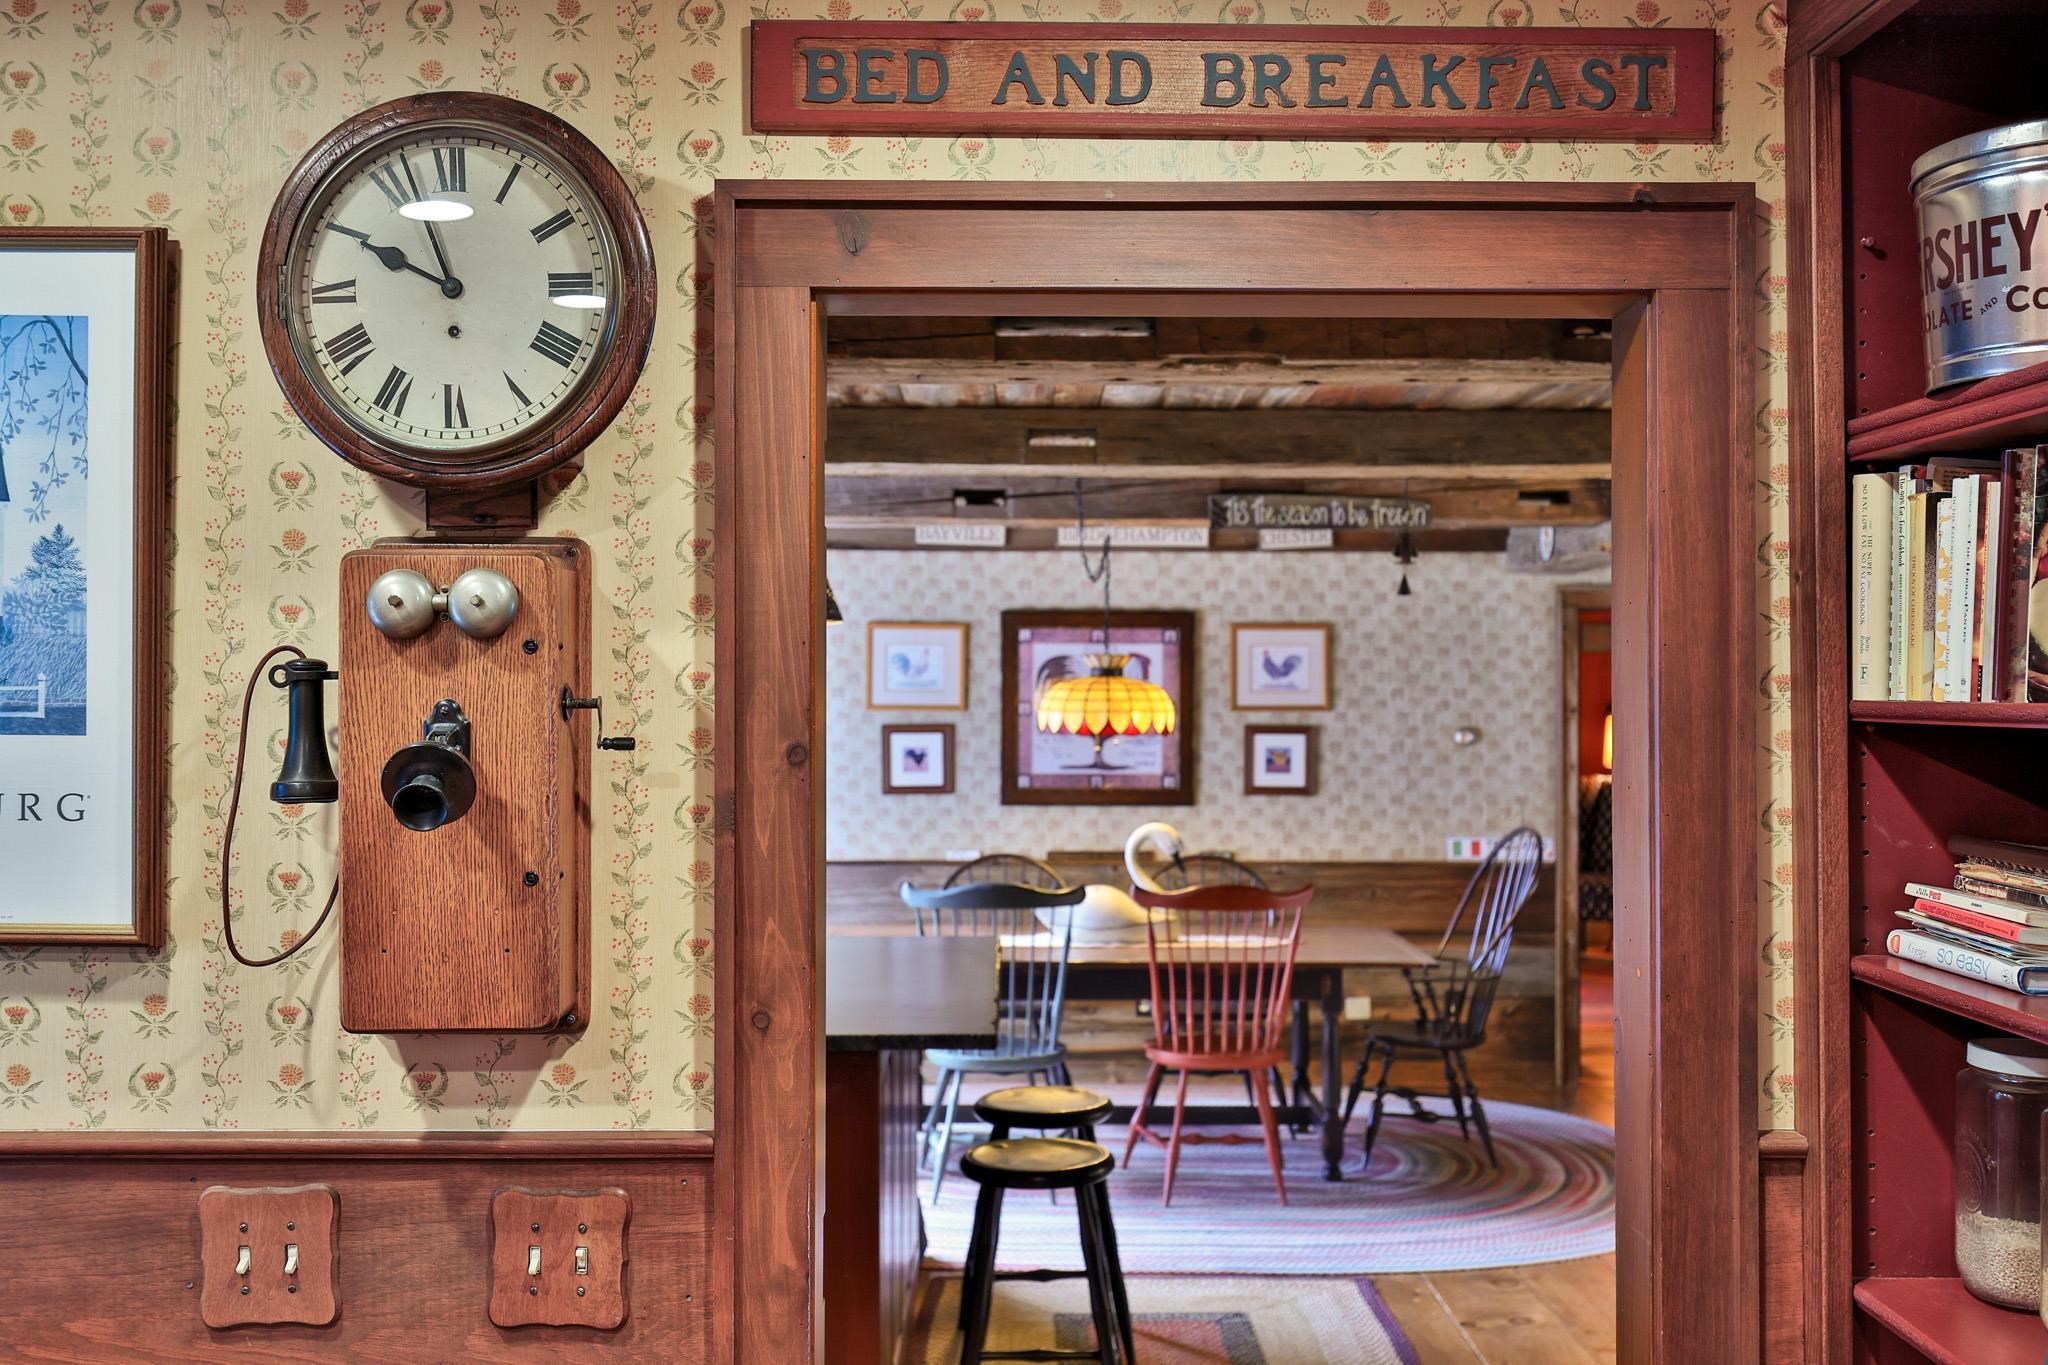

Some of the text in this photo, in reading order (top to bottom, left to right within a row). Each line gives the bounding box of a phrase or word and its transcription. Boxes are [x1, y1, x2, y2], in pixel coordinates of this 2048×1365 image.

[800, 49, 1668, 110] BED AND BREAKFAST
[1980, 296, 1999, 315] AND
[1277, 504, 1328, 526] season
[1330, 500, 1347, 526] to
[1348, 498, 1369, 527] be
[1937, 948, 1954, 965] so
[1956, 953, 1992, 980] easy
